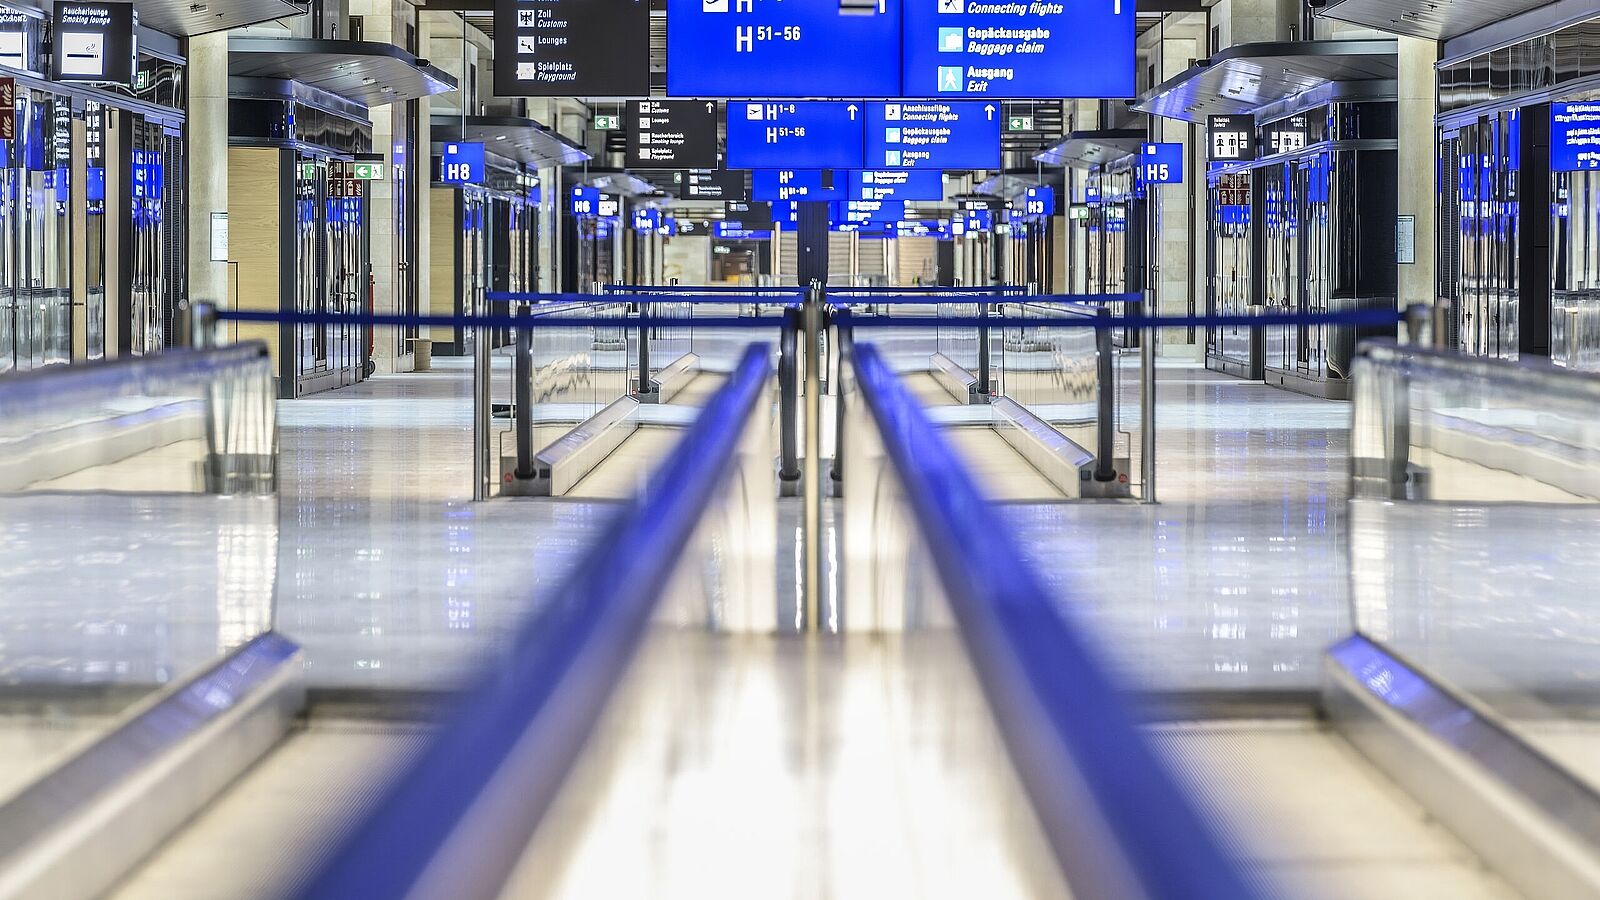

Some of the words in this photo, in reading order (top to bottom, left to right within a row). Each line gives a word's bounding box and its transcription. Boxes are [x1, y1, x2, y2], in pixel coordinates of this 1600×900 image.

[63, 7, 108, 16] Raucherlounge
[537, 9, 552, 18] Zoll
[967, 2, 1027, 16] Connecting
[1029, 2, 1063, 16] flights
[62, 15, 87, 24] Smoking
[89, 16, 111, 26] lounge
[537, 19, 568, 28] Customs
[736, 26, 753, 52] H
[967, 26, 1050, 41] Gepäckausgabe
[538, 35, 568, 46] Lounges
[967, 41, 1014, 56] Baggage
[1015, 41, 1045, 53] claim
[537, 61, 573, 72] Spielplatz
[537, 71, 577, 82] Playground
[967, 66, 1014, 80] Ausgang
[967, 80, 989, 92] Exit
[766, 104, 777, 121] H
[902, 112, 938, 122] Connecting
[938, 112, 959, 122] flights
[766, 127, 778, 144] H
[902, 127, 951, 136] Gepäckausgabe
[902, 136, 930, 145] Baggage
[930, 136, 948, 144] claim
[902, 150, 930, 160] Ausgang
[902, 159, 916, 167] Exit
[447, 163, 470, 181] H8
[1147, 164, 1169, 181] H5
[1028, 200, 1044, 214] H3
